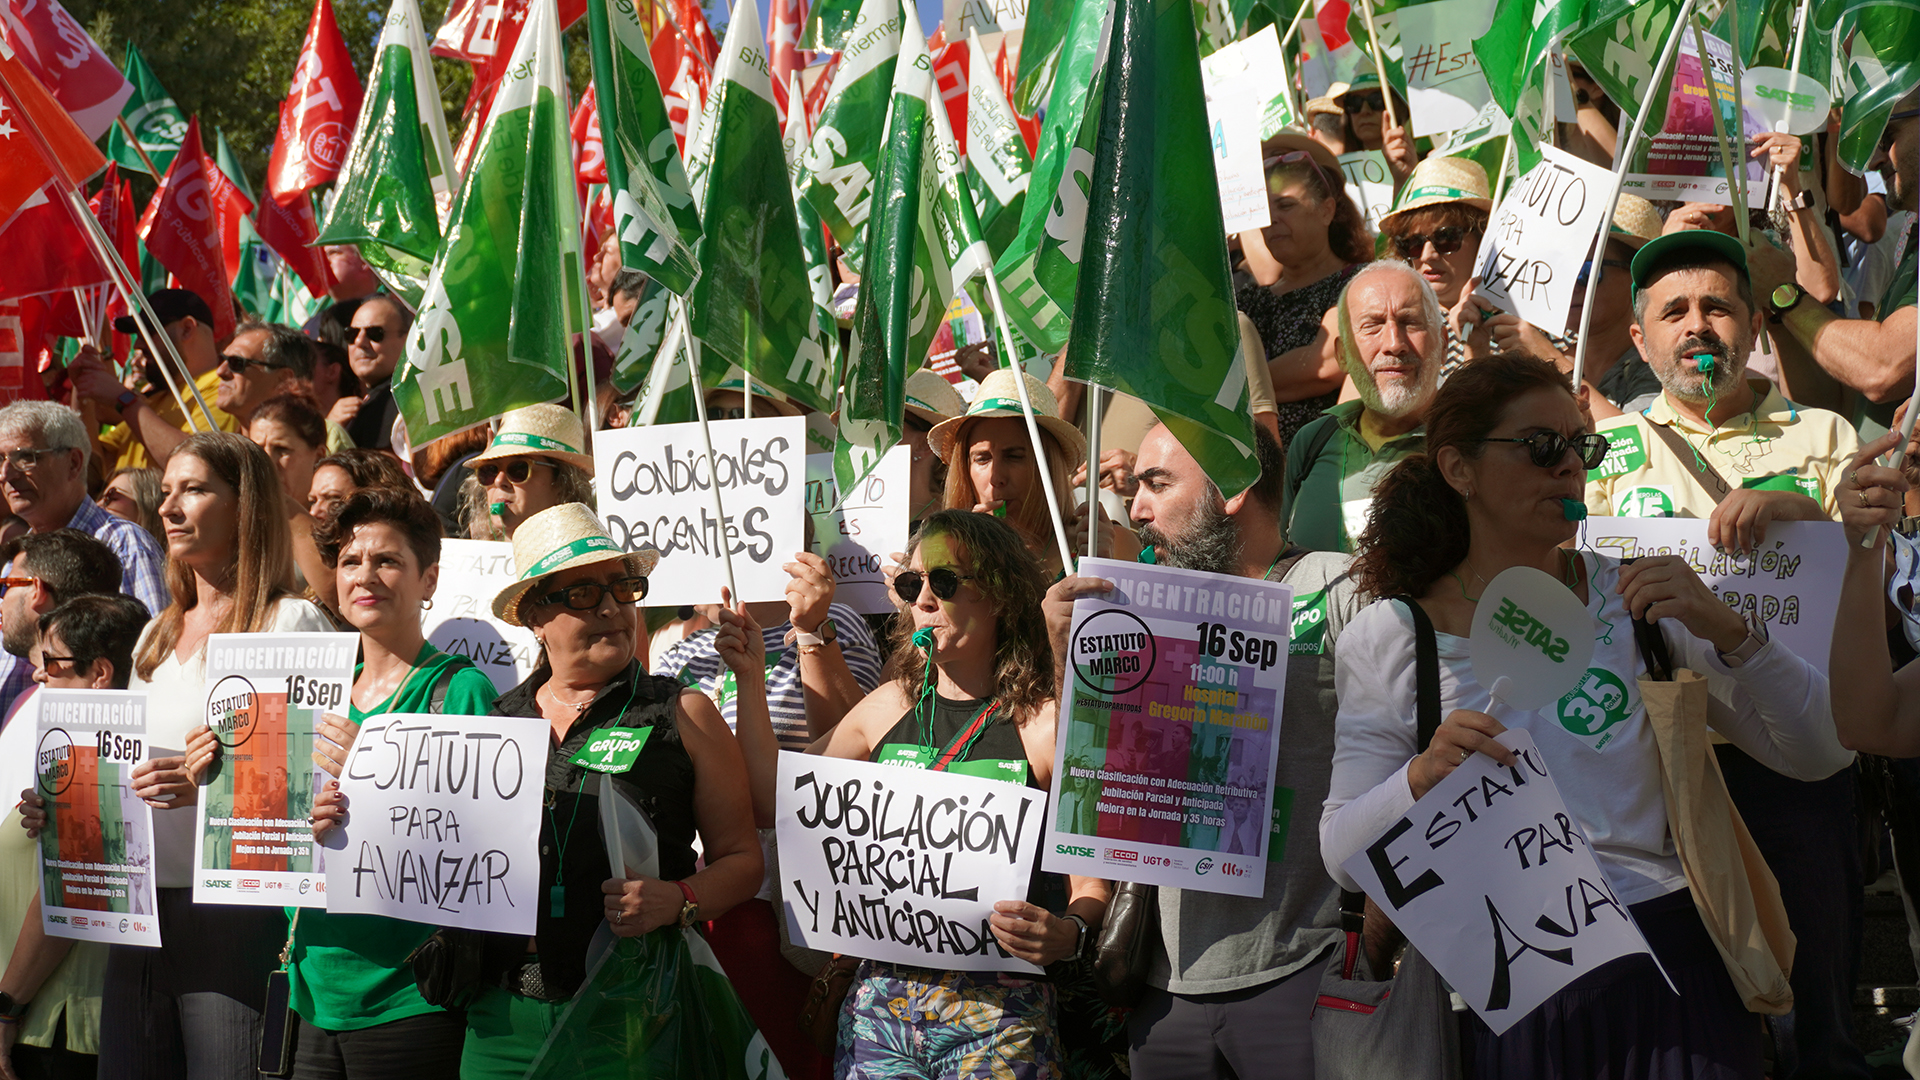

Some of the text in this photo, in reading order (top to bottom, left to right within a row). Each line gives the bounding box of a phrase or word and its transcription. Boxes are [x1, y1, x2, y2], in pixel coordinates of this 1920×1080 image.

[1755, 84, 1816, 107] SATSE
[1088, 574, 1282, 625] ONCENTRACIÓN
[1079, 631, 1147, 655] ESTATUTO
[1196, 621, 1279, 671] 16 Sep
[213, 642, 350, 671] CONCENTRACIÓN
[1089, 655, 1141, 677] MARCO
[1189, 662, 1240, 687] 11:00 h
[211, 692, 253, 717] ESTATUTO
[286, 675, 344, 711] 16 Sep
[1075, 697, 1143, 715] #ESTATUTOPARATODAS
[1184, 685, 1239, 708] Hospital
[1563, 674, 1624, 733] 35
[1606, 692, 1622, 712] HORAS
[42, 699, 142, 726] CONCENTRACIÓN
[217, 712, 250, 734] MARCO
[1149, 700, 1269, 732] Gregorio Marañón
[40, 744, 71, 765] ESTATUTO
[96, 730, 142, 765] 16 Sep
[589, 739, 641, 753] GRUPO
[601, 749, 615, 763] A
[45, 763, 69, 782] MARCO
[348, 720, 524, 801] ESTATUTO
[1069, 765, 1259, 800] Nueva Clasificación con Adecuación Retributiva
[1101, 786, 1225, 812] Jubilación Parcial y Anticipada
[390, 805, 461, 843] PARA
[1096, 801, 1226, 828] Mejora en la Jornada y 35 horas
[1504, 811, 1585, 870] PAR
[1055, 844, 1096, 859] SATSE
[1113, 850, 1137, 861] CCOO
[1143, 855, 1163, 868] UGT
[205, 879, 233, 889] SATSE
[264, 881, 278, 890] UGT
[353, 840, 516, 914] AVANZAR
[793, 879, 820, 933] Y
[50, 914, 68, 925] SATSE
[1484, 877, 1628, 1012] AVA
